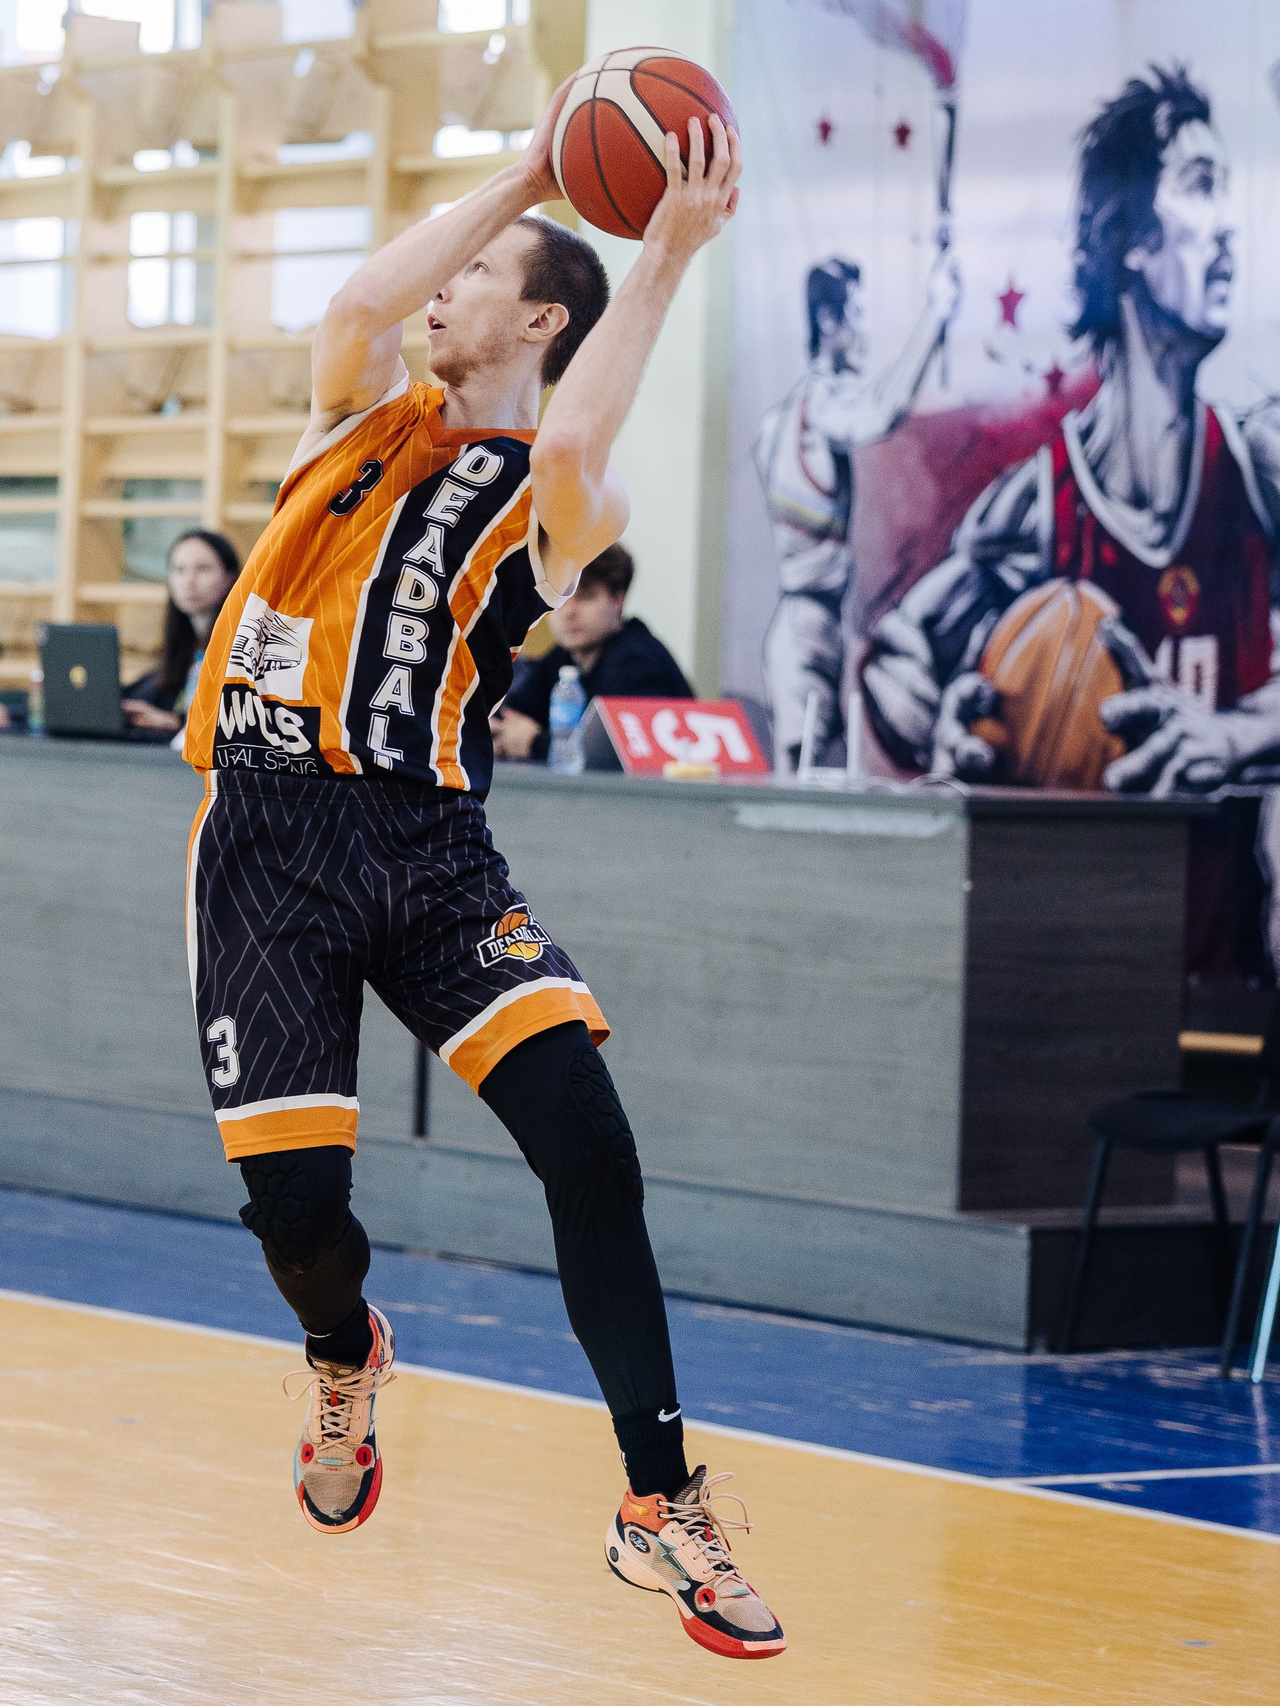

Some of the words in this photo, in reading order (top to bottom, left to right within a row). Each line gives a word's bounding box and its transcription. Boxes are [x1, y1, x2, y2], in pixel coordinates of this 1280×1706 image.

[328, 459, 384, 517] 3
[217, 748, 259, 768] URAL
[650, 708, 752, 763] 5
[207, 1015, 241, 1088] 3
